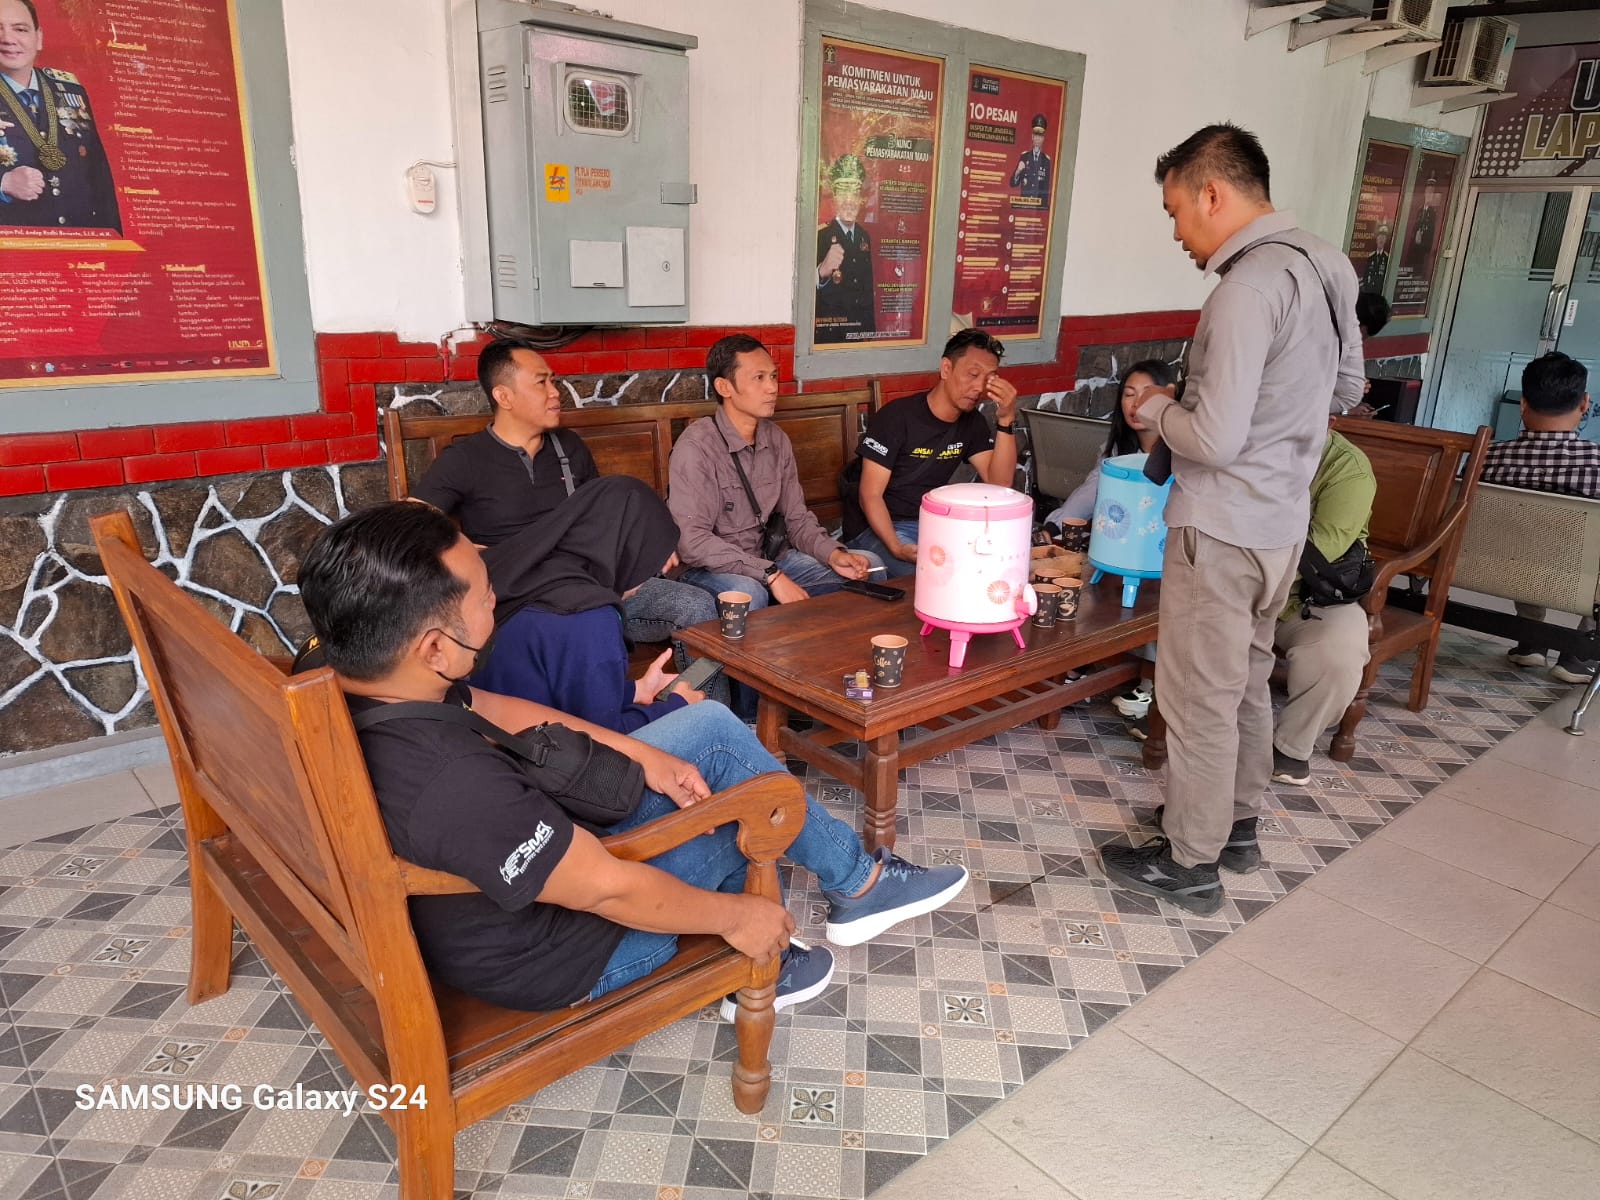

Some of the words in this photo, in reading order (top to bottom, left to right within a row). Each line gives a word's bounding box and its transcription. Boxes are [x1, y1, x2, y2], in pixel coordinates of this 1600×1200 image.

[841, 63, 891, 83] KOMITMEN
[892, 72, 921, 88] UNTUK
[827, 75, 909, 98] PEMASYARAKATAN
[910, 87, 934, 101] MAJU
[969, 102, 985, 120] 10
[986, 106, 1018, 124] PESAN
[896, 138, 913, 150] KUNCI
[1521, 114, 1600, 159] LAP
[866, 146, 914, 161] PEMASYARAKATAN
[722, 609, 740, 621] Coffee
[873, 655, 892, 668] Coffee
